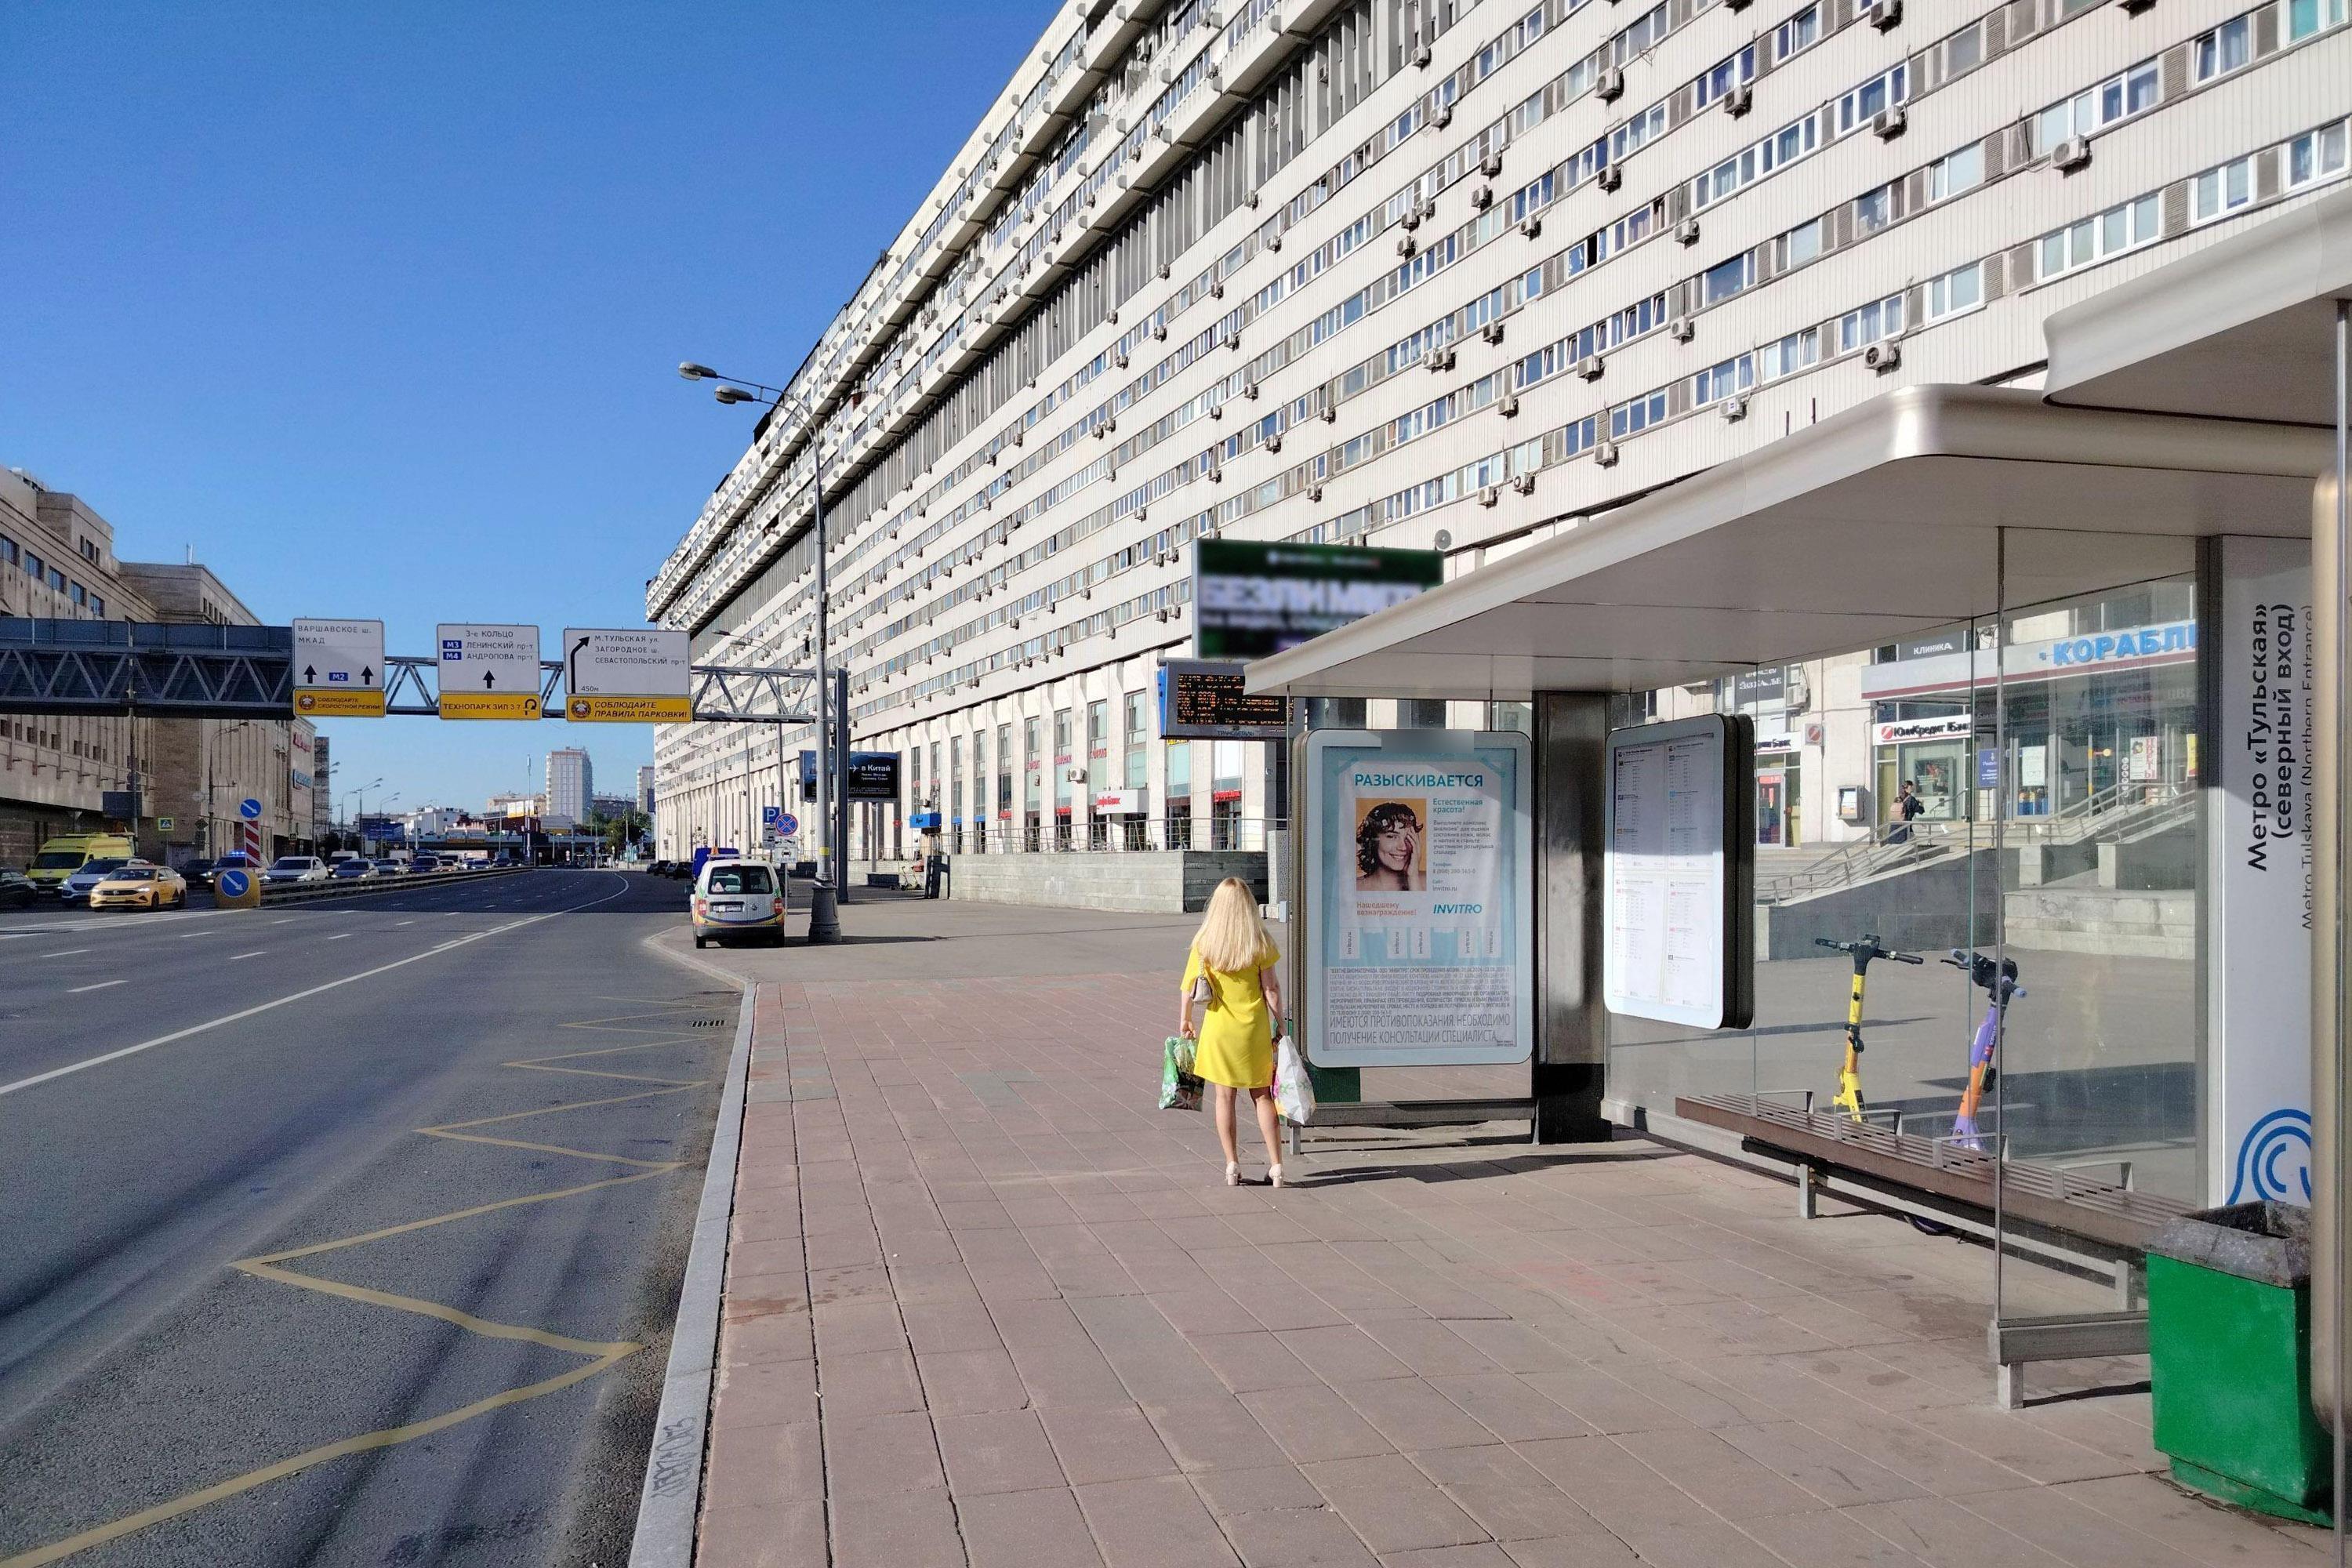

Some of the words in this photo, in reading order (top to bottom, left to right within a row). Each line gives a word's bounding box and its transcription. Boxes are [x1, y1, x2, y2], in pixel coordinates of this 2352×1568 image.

[2270, 604, 2295, 678] вход)
[1913, 642, 1954, 655] КЛИНИКА
[2247, 603, 2271, 764] «Тульская»
[594, 701, 657, 710] СОБЛЮДАЙТЕ
[2301, 698, 2312, 786] (Northern
[2270, 688, 2296, 839] (северный
[1355, 773, 1483, 787] РАЗЫСКИВАЕТСЯ
[2247, 773, 2271, 872] Метро
[1433, 904, 1483, 914] INVITRO
[2302, 874, 2312, 930] Metro
[1356, 909, 1417, 917] вознаграждение!
[1330, 1015, 1368, 1028] ИМЕЮТСЯ
[1370, 1014, 1456, 1027] ПРОТИВОПОКАЗАНИЯ.
[1457, 1014, 1510, 1026] НЕОБХОДИМО
[1330, 1032, 1377, 1044] ПОЛУЧЕНИЕ
[1380, 1031, 1440, 1044] КОНСУЛЬТАЦИИ
